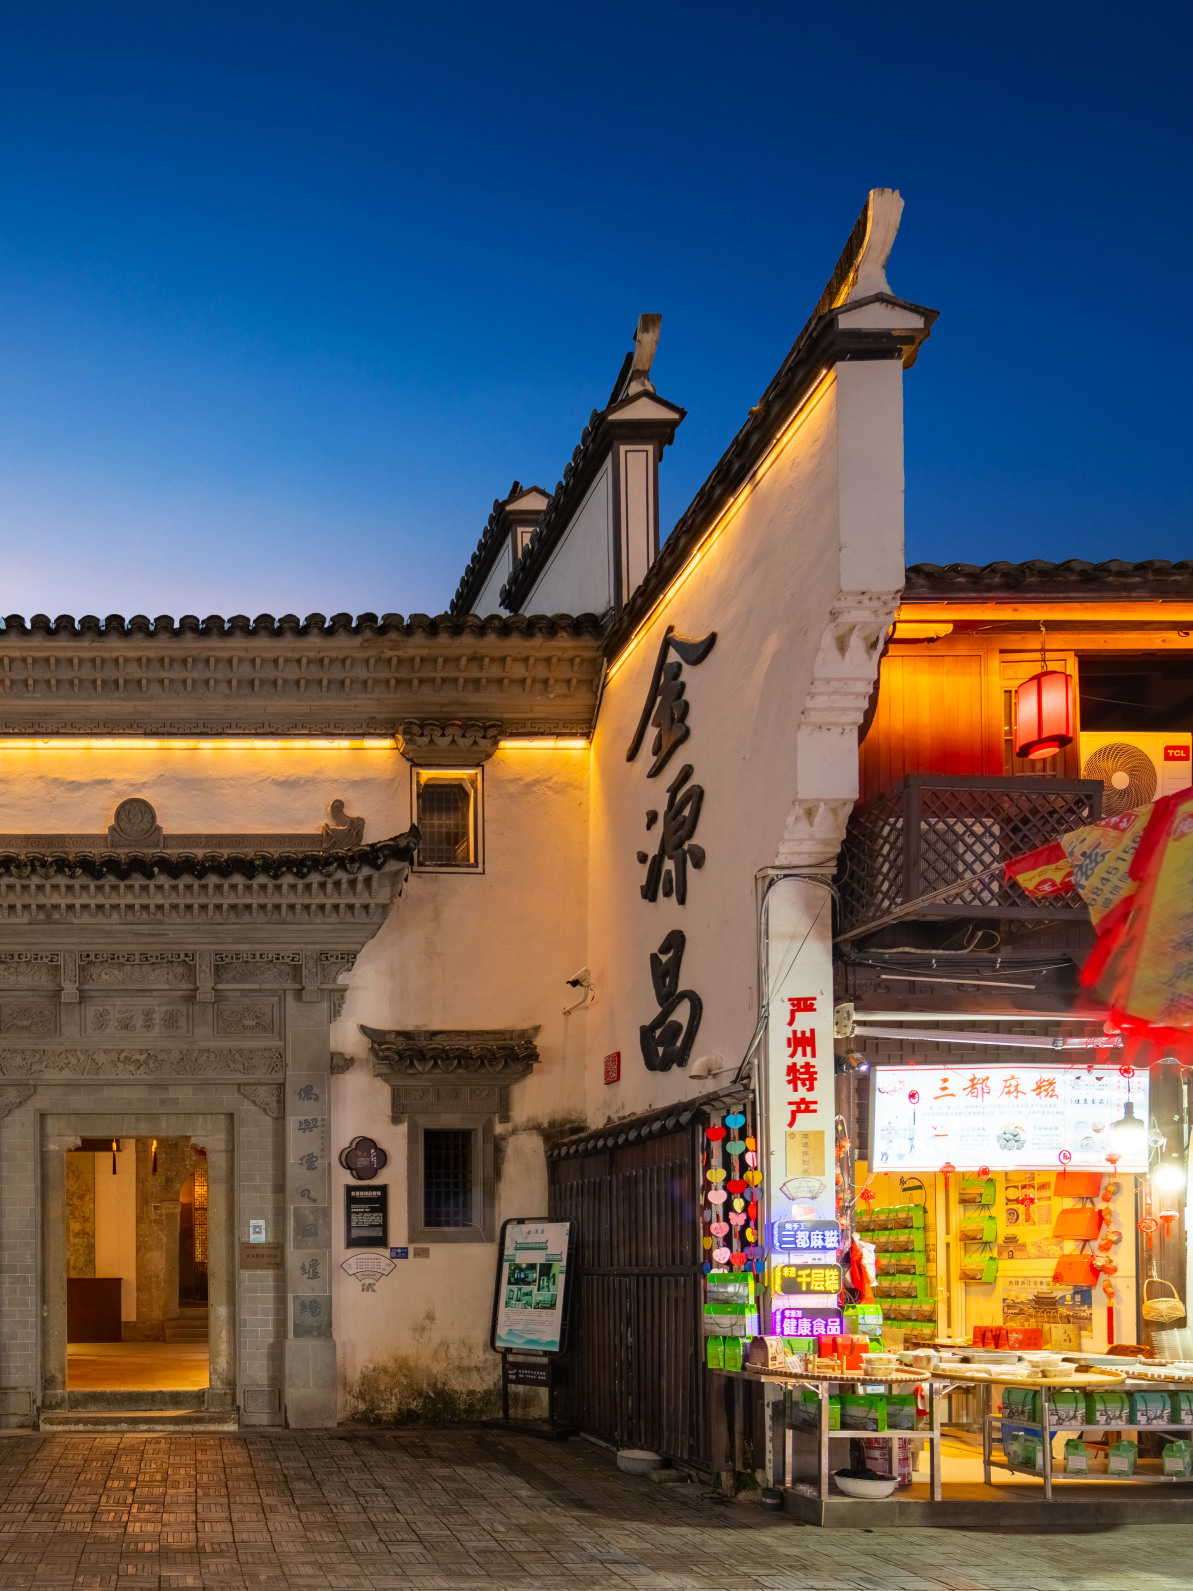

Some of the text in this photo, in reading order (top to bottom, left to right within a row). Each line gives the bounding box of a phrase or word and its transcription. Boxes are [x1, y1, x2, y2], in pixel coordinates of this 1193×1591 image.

[1167, 749, 1187, 757] TCL
[625, 623, 717, 1072] 金源昌
[785, 996, 818, 1129] 严州特产
[932, 1072, 1060, 1103] 三都麻糍
[781, 1230, 840, 1249] 三都麻糍
[796, 1268, 840, 1293] 千层糕
[782, 1317, 841, 1337] 健康食品
